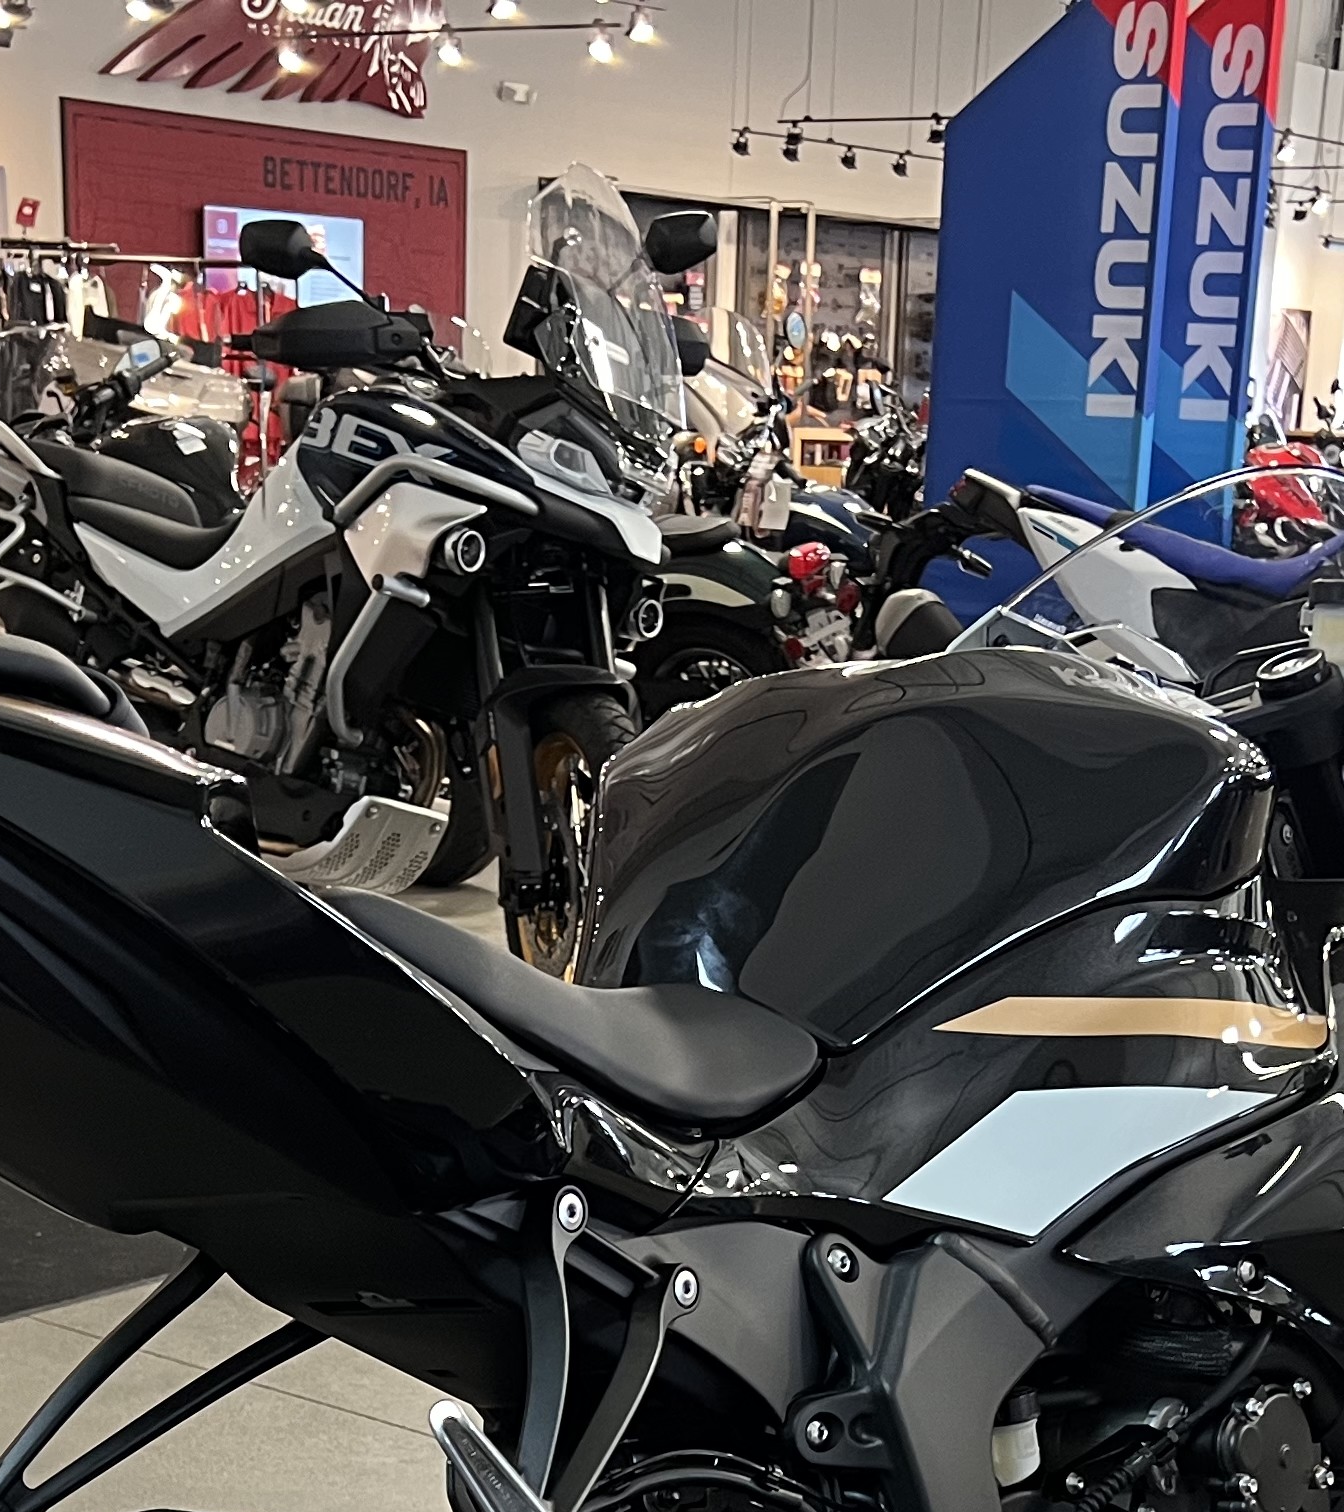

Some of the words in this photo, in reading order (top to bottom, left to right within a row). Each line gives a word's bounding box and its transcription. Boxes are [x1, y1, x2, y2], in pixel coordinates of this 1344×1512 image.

[263, 155, 420, 208] BETTENDORF,
[428, 174, 449, 208] IA
[1085, 1, 1169, 418] SUZUKI
[1179, 23, 1265, 422] SUZUKI
